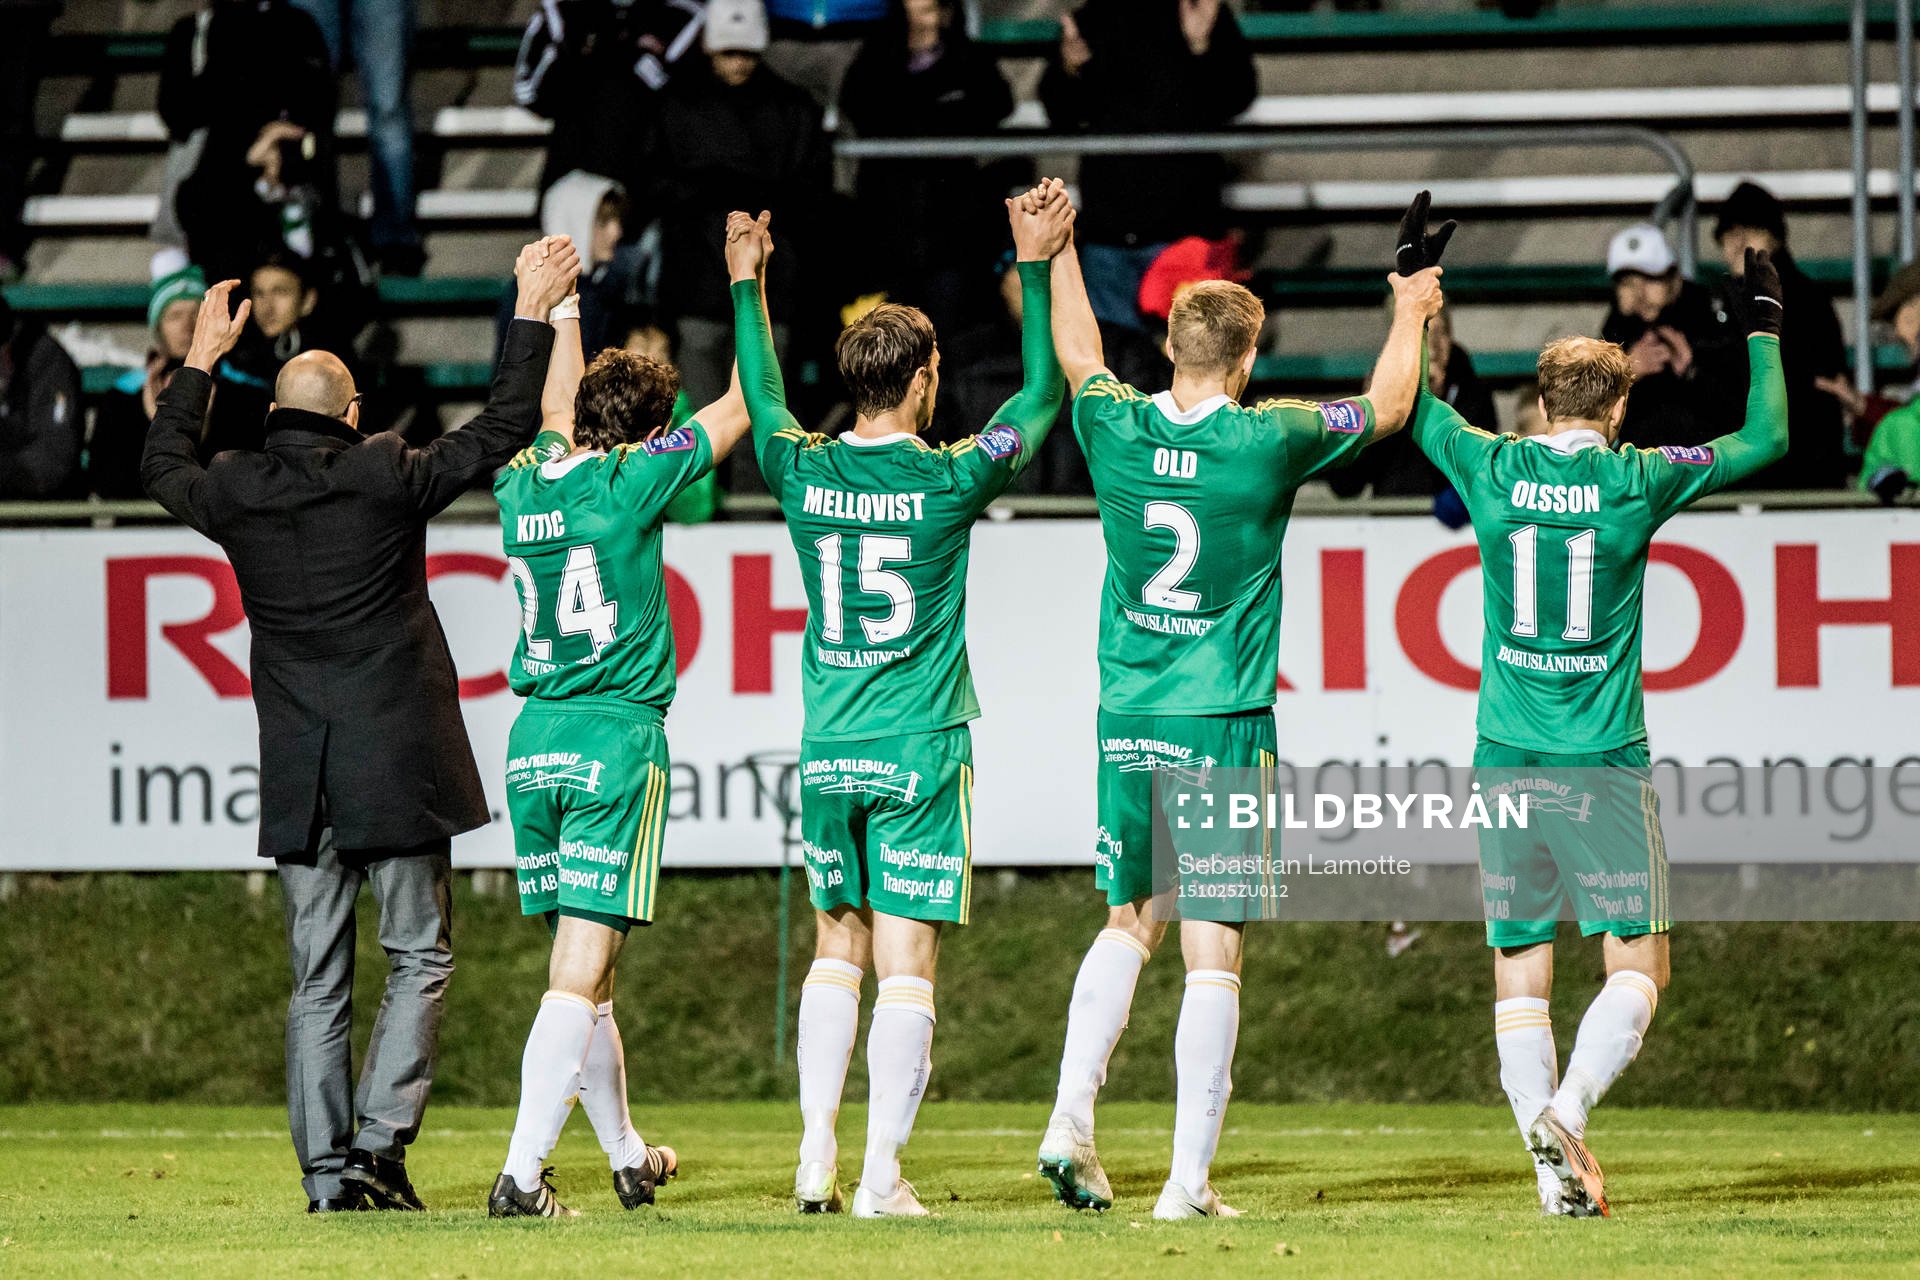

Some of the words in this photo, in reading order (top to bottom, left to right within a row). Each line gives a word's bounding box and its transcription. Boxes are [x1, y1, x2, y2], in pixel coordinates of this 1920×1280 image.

[1153, 447, 1198, 479] OLD
[803, 485, 925, 523] MELLQVIST
[1511, 480, 1600, 514] OLSSON
[516, 509, 566, 543] KITIC
[1142, 500, 1201, 612] 2
[814, 532, 916, 646] 15
[1508, 523, 1597, 642] 11
[507, 544, 618, 661] 24
[1277, 543, 1920, 693] ICOH
[1496, 645, 1609, 673] BOHUSLÄNINGEN
[879, 842, 964, 877] ThageSvanberg
[541, 873, 559, 892] AB
[600, 873, 618, 892] AB
[828, 869, 844, 888] AB
[882, 872, 935, 901] Transport
[936, 879, 955, 899] AB
[1496, 899, 1510, 919] AB
[1627, 895, 1644, 914] AB
